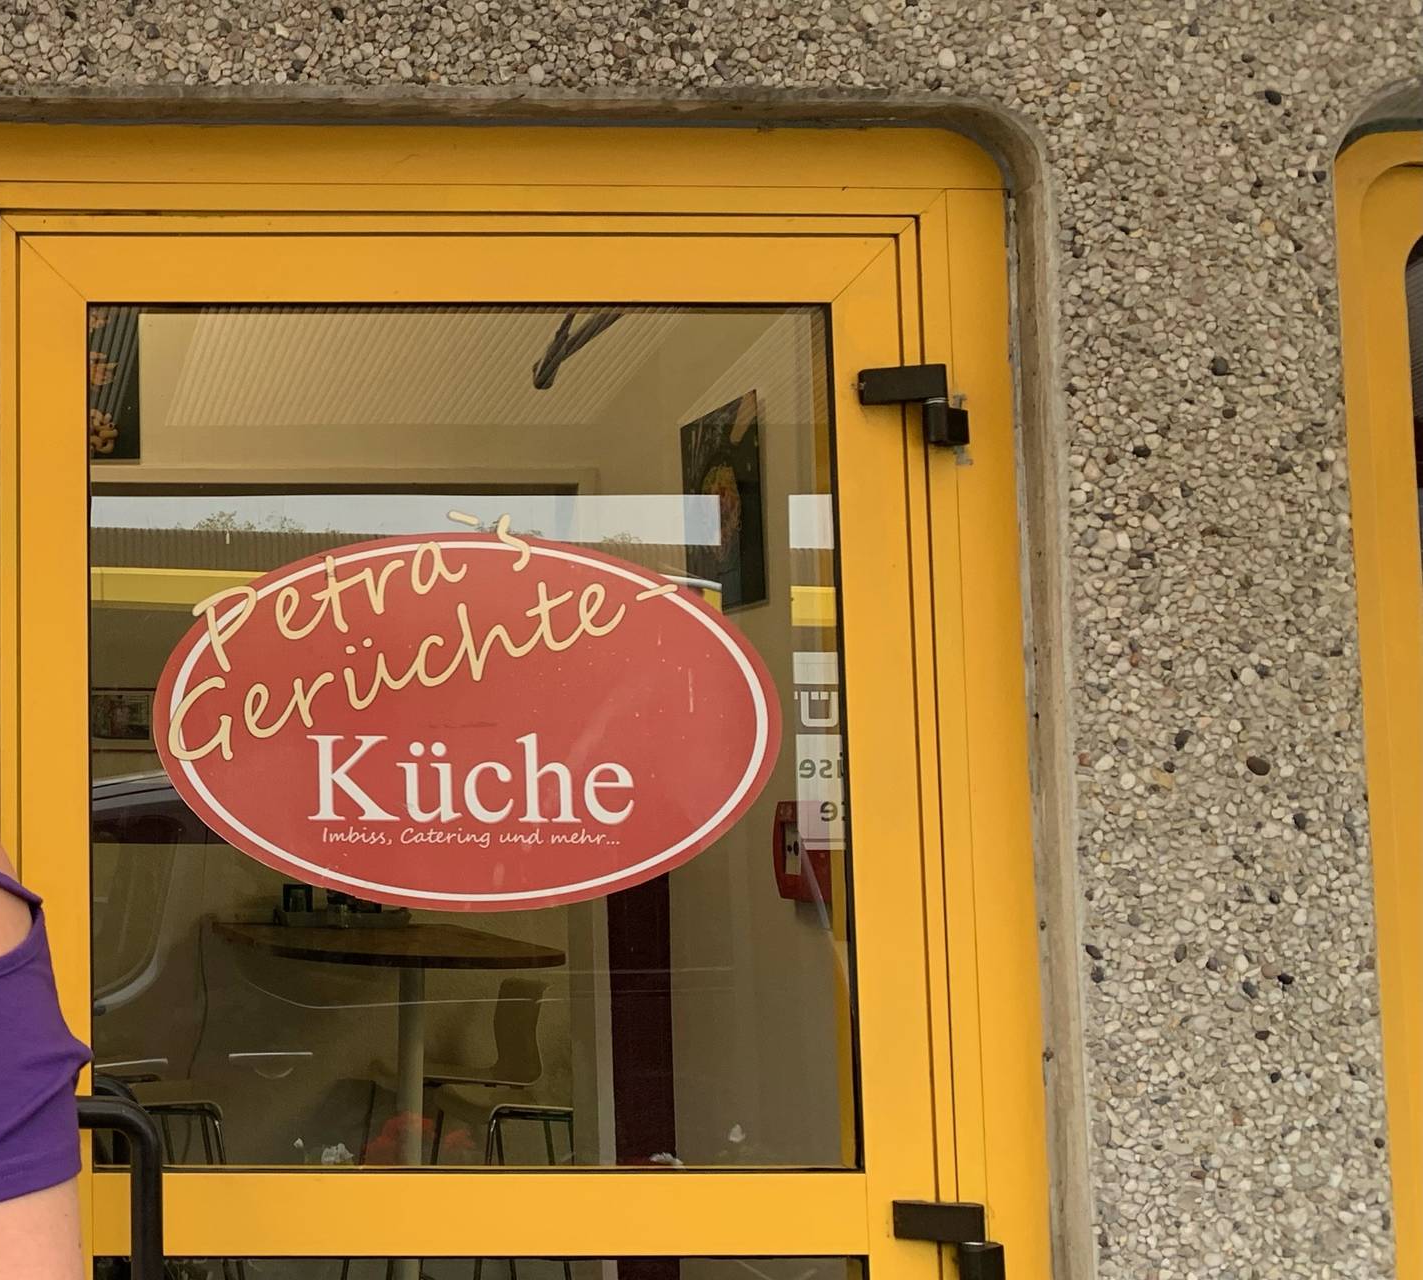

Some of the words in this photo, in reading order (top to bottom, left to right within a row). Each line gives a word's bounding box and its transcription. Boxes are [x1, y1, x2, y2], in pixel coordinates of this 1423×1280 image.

[305, 732, 635, 825] Küche
[322, 827, 393, 845] Imbiss,
[399, 827, 491, 848] Catering
[499, 828, 543, 846] und
